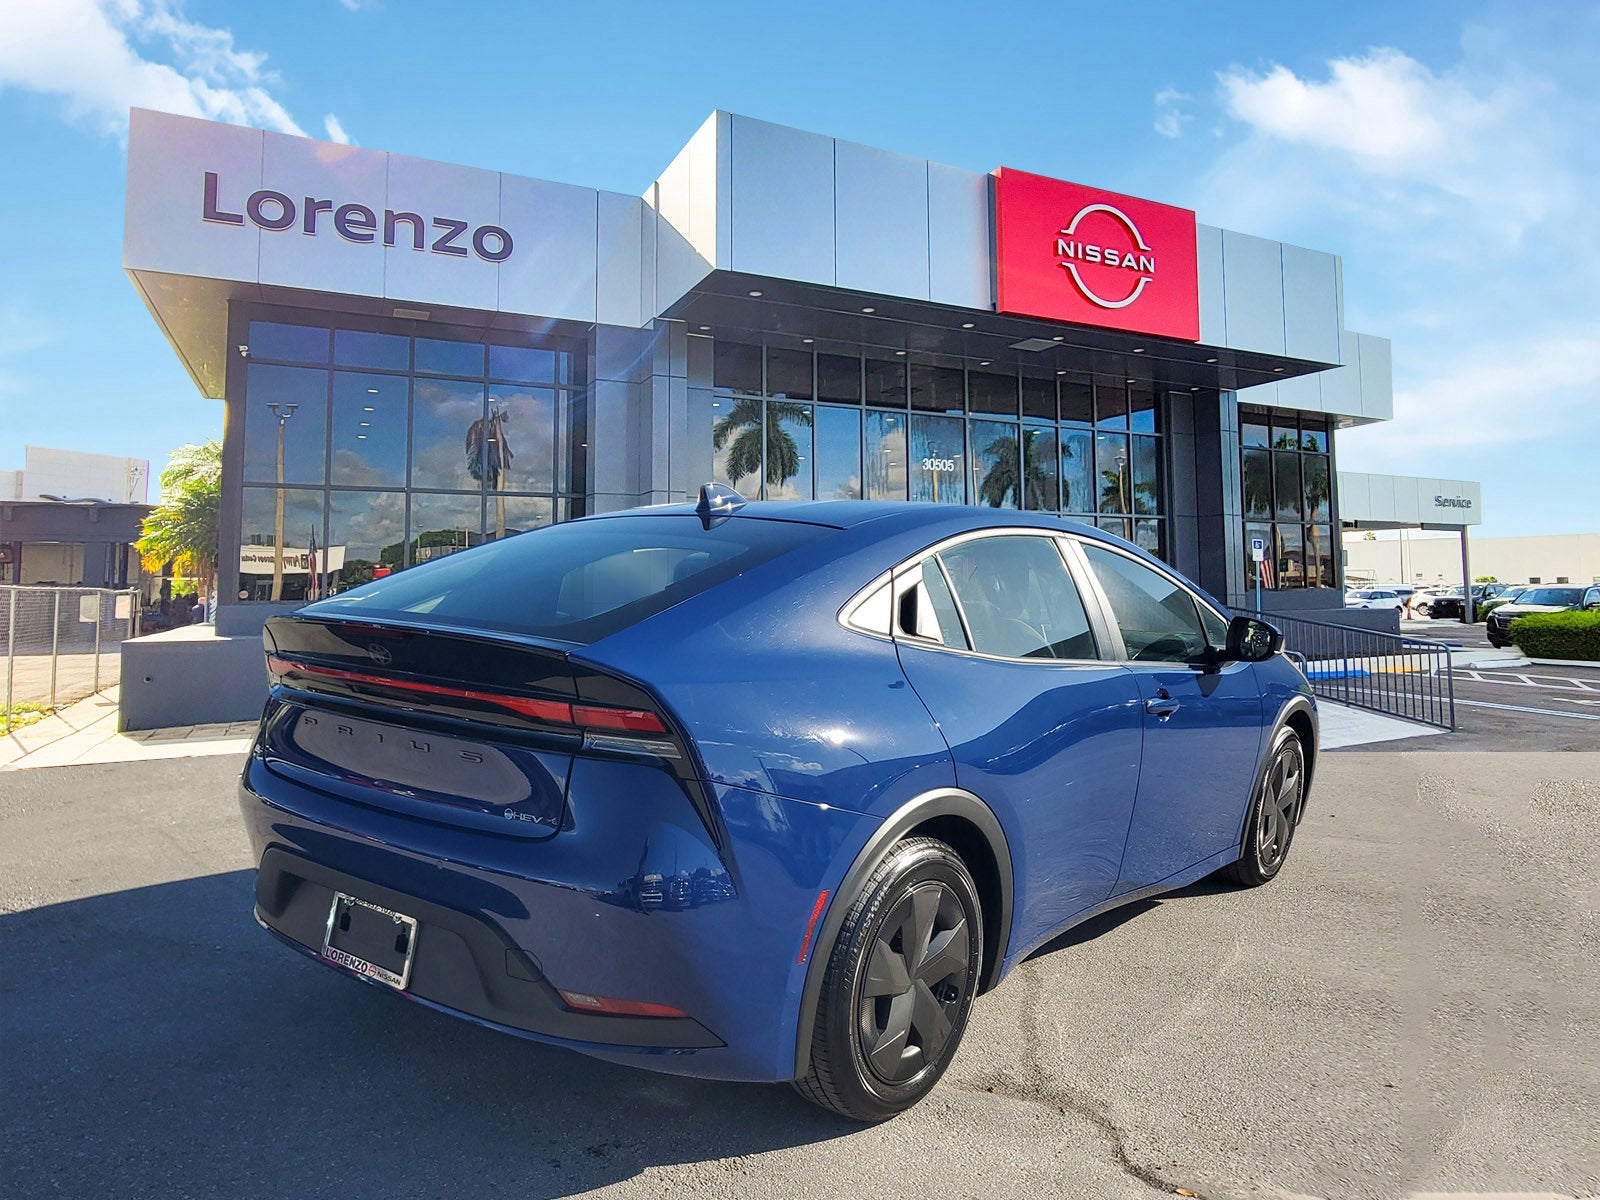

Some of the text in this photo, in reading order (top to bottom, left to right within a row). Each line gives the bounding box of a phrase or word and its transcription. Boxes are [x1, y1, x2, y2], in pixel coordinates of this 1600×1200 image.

[202, 171, 514, 262] Lorenzo
[1057, 238, 1156, 273] NISSAN
[922, 458, 955, 471] 30505
[1434, 495, 1472, 509] Service
[304, 716, 483, 764] PRIUS
[325, 946, 401, 986] LORENZO NISSAN
